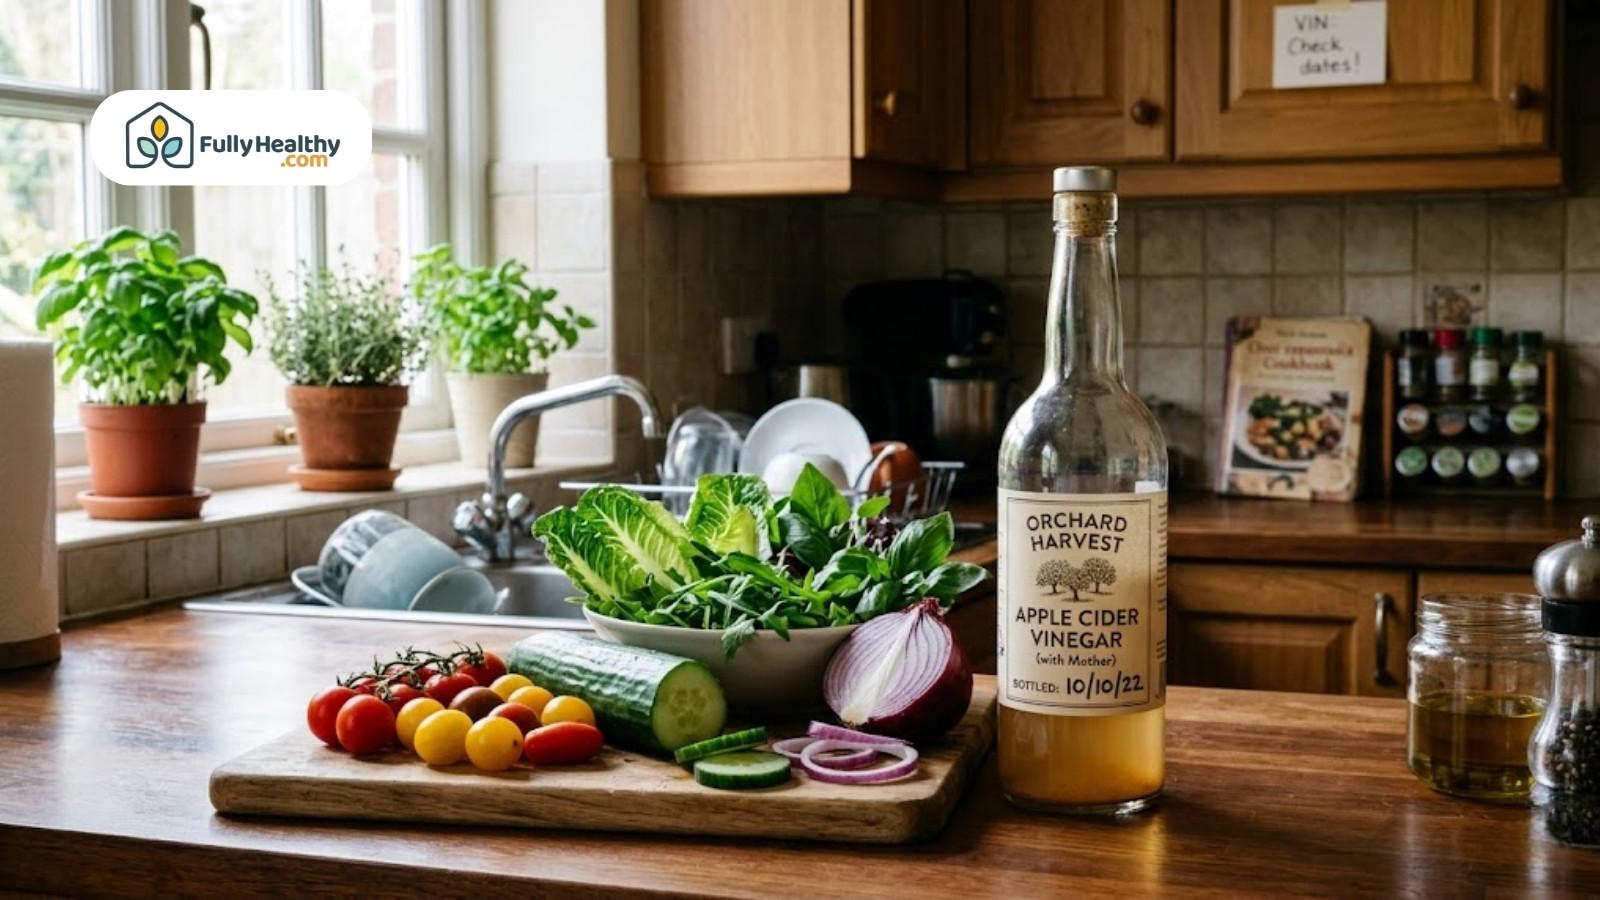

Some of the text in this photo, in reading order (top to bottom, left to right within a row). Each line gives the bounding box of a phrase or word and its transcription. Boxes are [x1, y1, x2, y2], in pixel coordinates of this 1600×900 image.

[1286, 36, 1344, 56] Check
[1299, 51, 1360, 76] dates!
[1026, 512, 1127, 532] ORCHARD
[1031, 533, 1125, 553] HARVEST
[1016, 606, 1139, 626] APPLE CIDER
[1031, 629, 1122, 648] VINEGAR
[1036, 652, 1117, 667] (with Mother)
[1013, 671, 1144, 700] BOTTLED: 10/10/22
